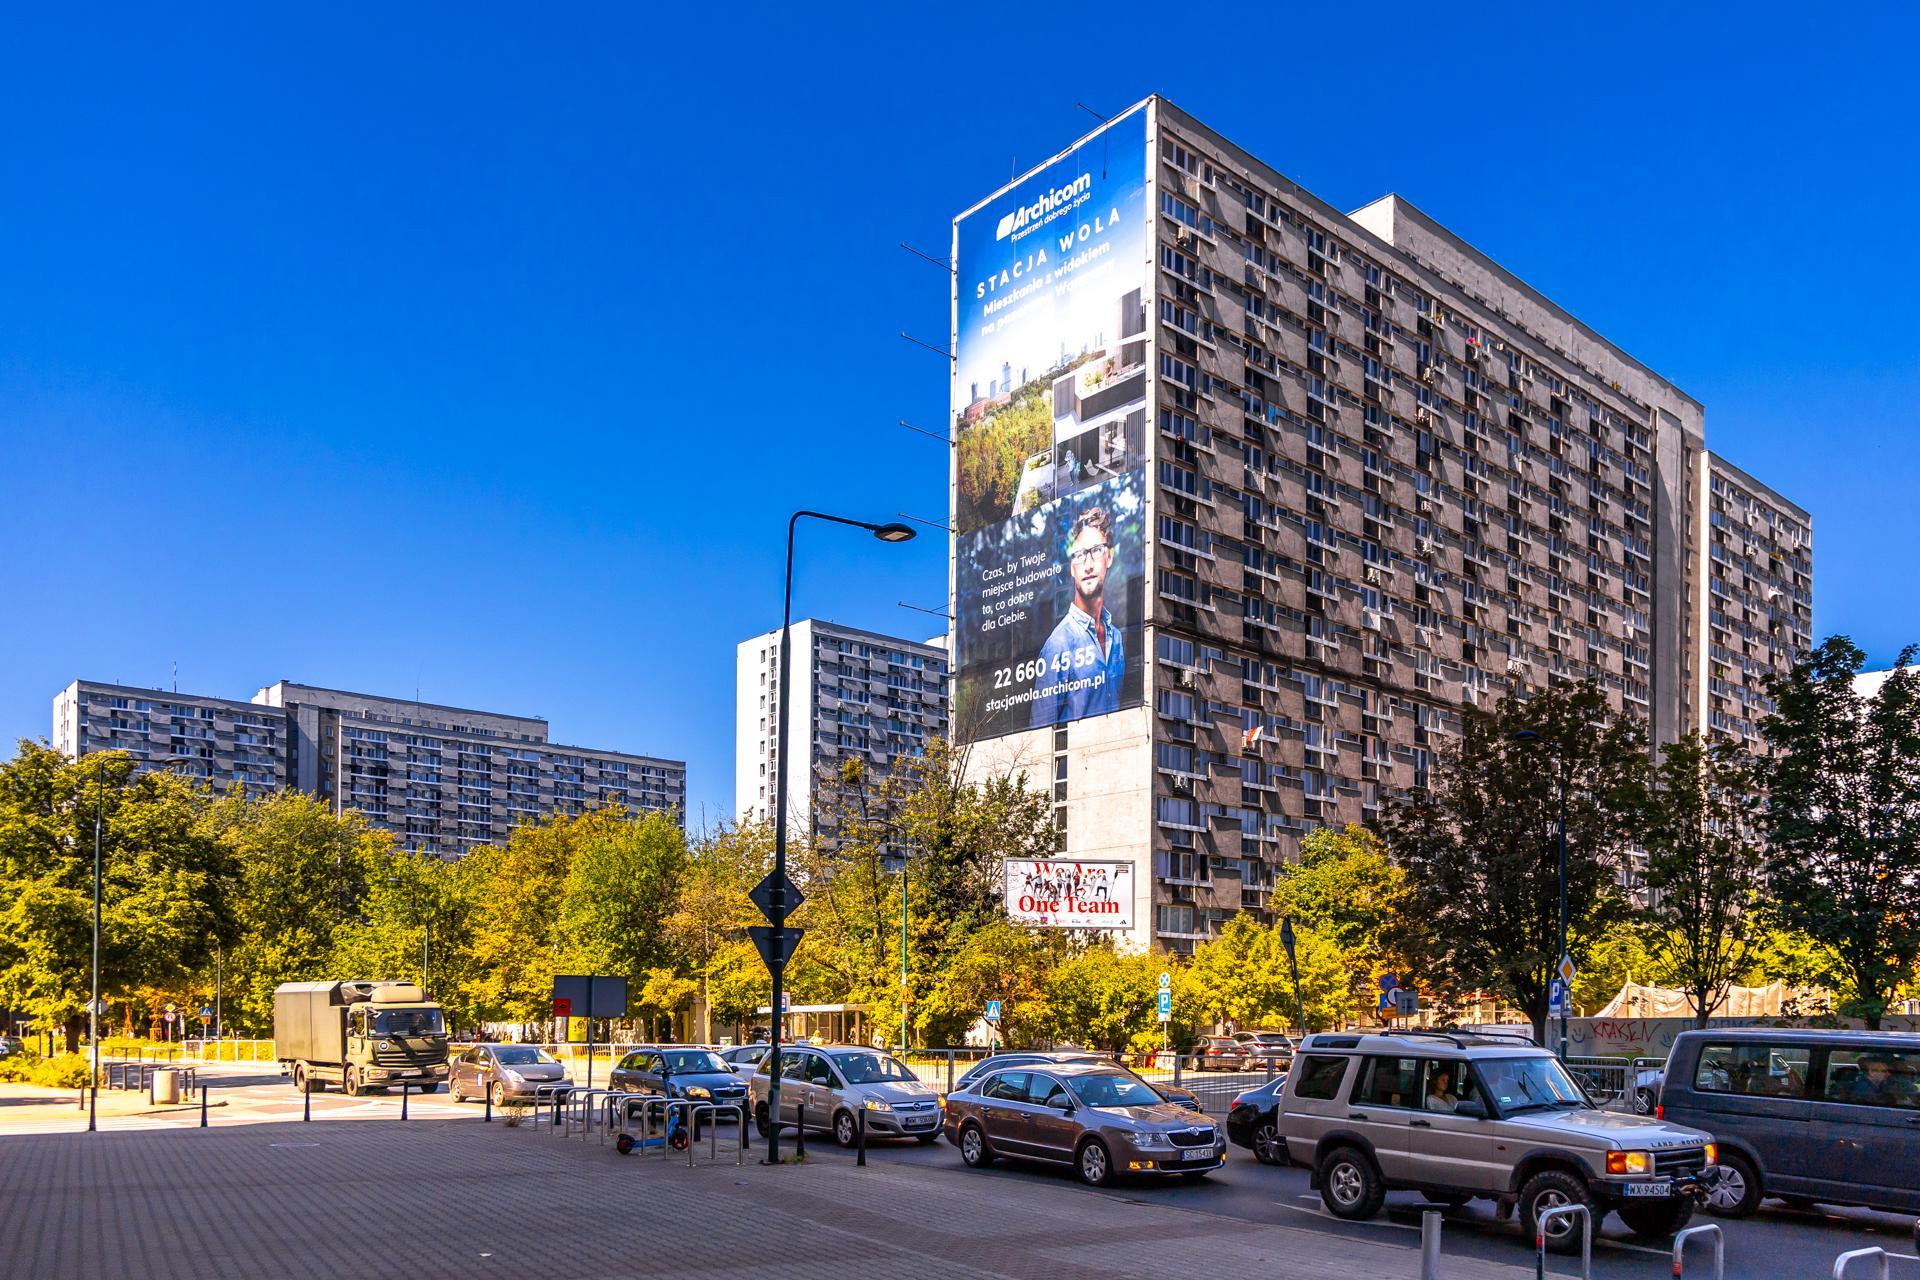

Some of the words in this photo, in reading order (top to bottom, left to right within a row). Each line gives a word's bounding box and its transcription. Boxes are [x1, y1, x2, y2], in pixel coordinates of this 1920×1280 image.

[1011, 219, 1044, 243] Przestrzeń
[1044, 204, 1072, 225] dobrego
[1073, 191, 1091, 208] życia
[1012, 173, 1091, 232] Archicom
[977, 249, 1048, 299] STACJA
[1059, 207, 1120, 253] WOLA
[983, 277, 1043, 317] Mieszkania
[1054, 241, 1110, 279] widokiem
[982, 567, 1005, 582] Czas,
[1007, 561, 1018, 574] by
[1020, 551, 1046, 568] Twoje
[982, 582, 1014, 599] miejsce
[1016, 563, 1062, 587] budowało
[982, 604, 993, 615] to,
[995, 600, 1006, 611] co
[1007, 592, 1034, 607] dobre
[982, 619, 996, 632] dla
[997, 610, 1027, 627] Ciebie.
[994, 667, 1012, 690] 22
[1015, 657, 1047, 683] 660
[1050, 650, 1071, 673] 45
[1074, 644, 1096, 669] 55
[985, 670, 1105, 712] stacjawola.archicom.pl
[1034, 862, 1066, 877] We
[1074, 863, 1107, 877] Are
[1019, 895, 1060, 913] One
[1064, 896, 1119, 914] Team
[1629, 1185, 1642, 1196] WX
[1644, 1184, 1670, 1196] 94504
